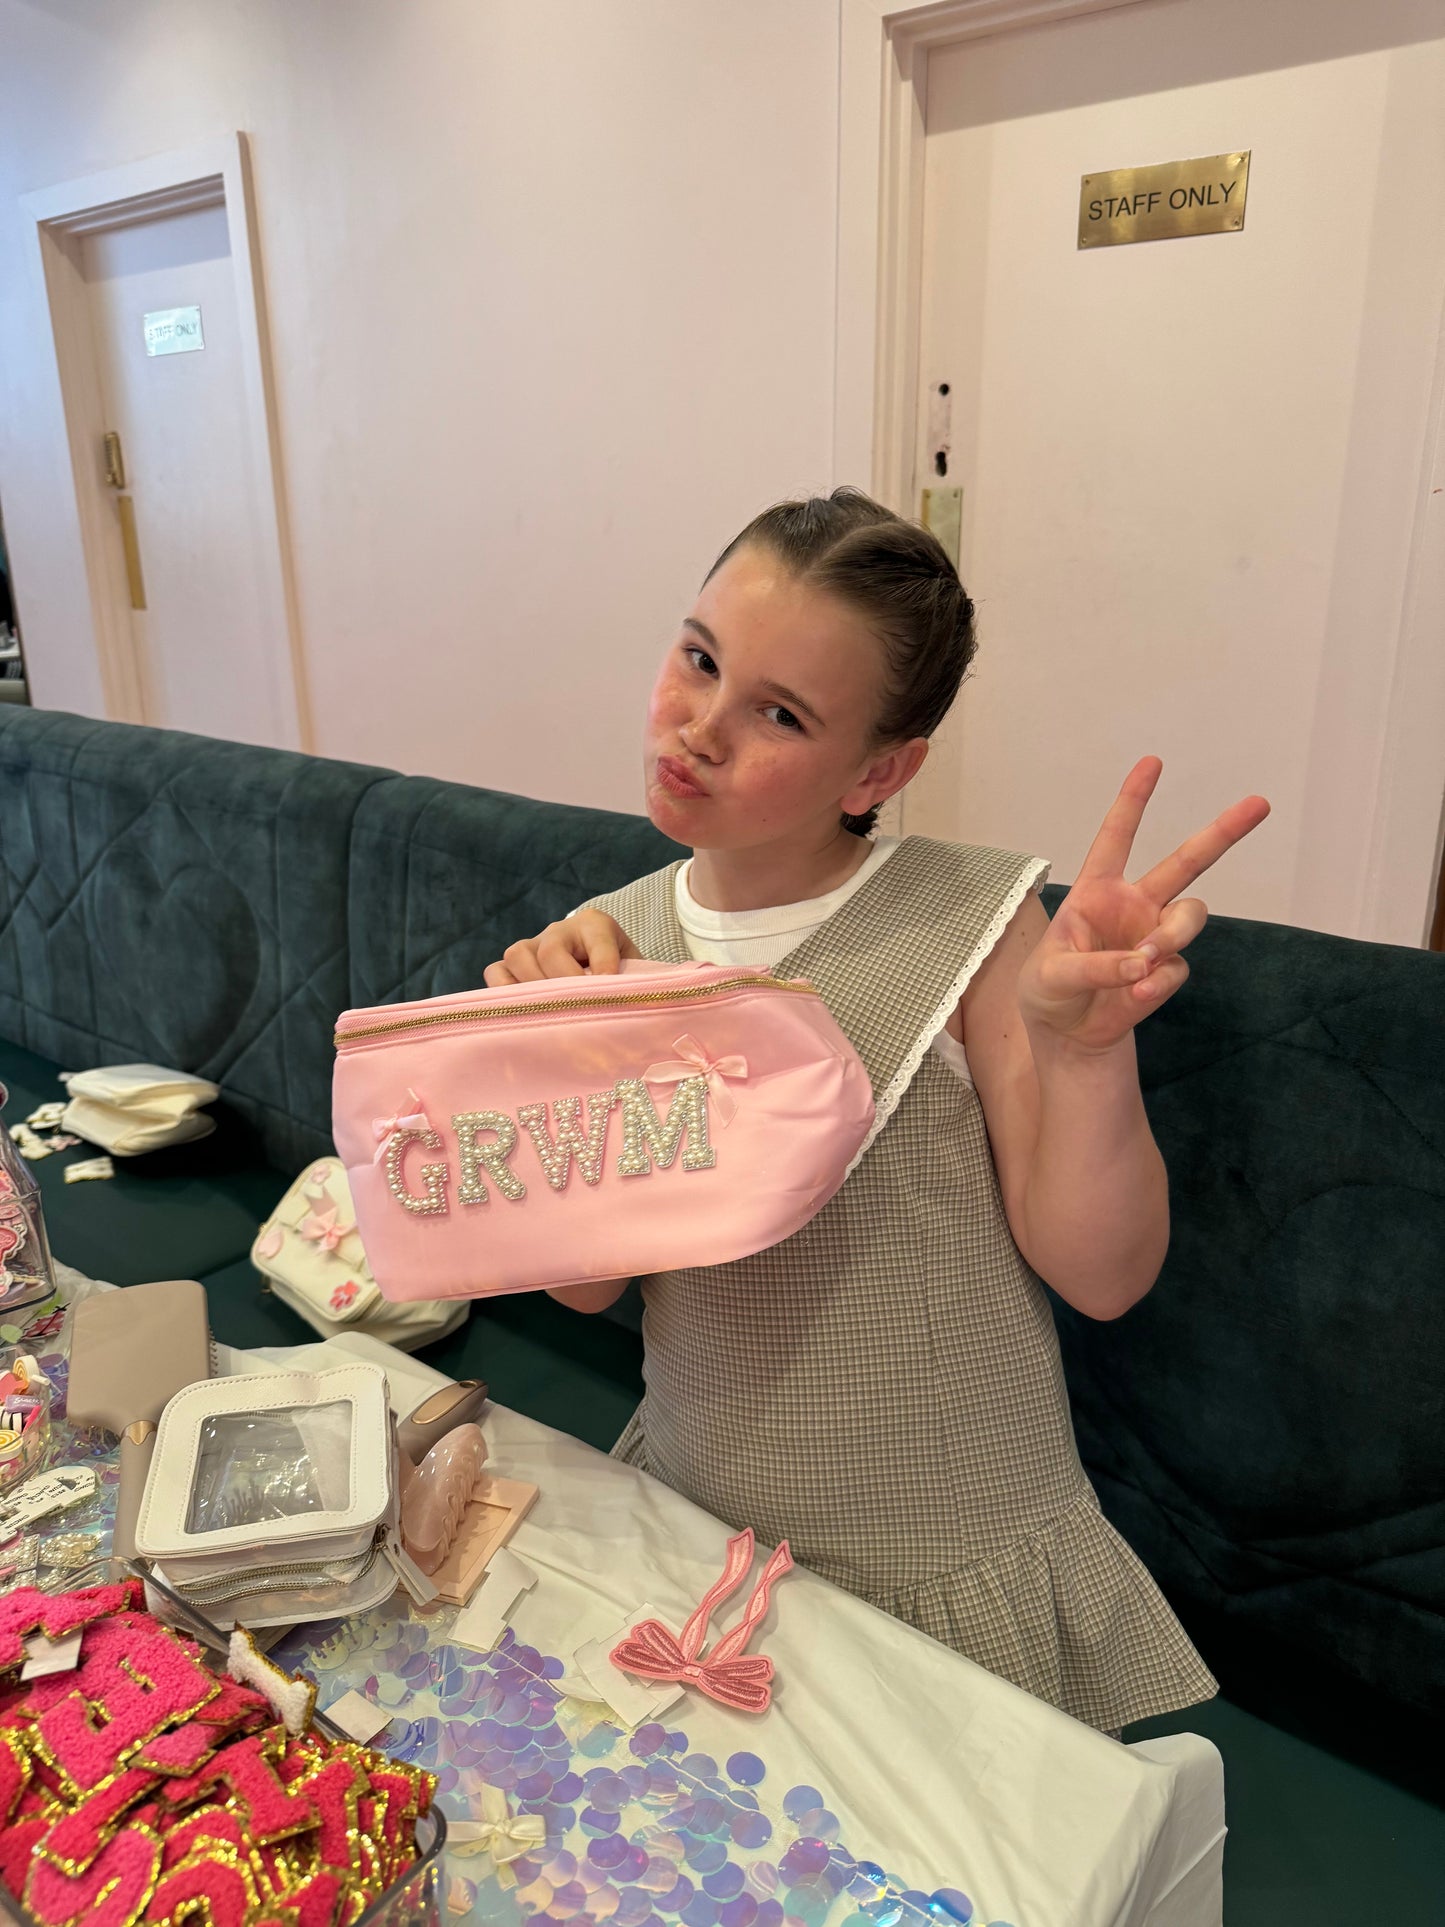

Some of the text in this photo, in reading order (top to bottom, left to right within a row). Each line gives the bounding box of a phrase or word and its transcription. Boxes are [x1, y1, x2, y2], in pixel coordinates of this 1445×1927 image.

[1088, 181, 1237, 221] STAFF ONLY
[385, 1076, 717, 1216] GRWM
